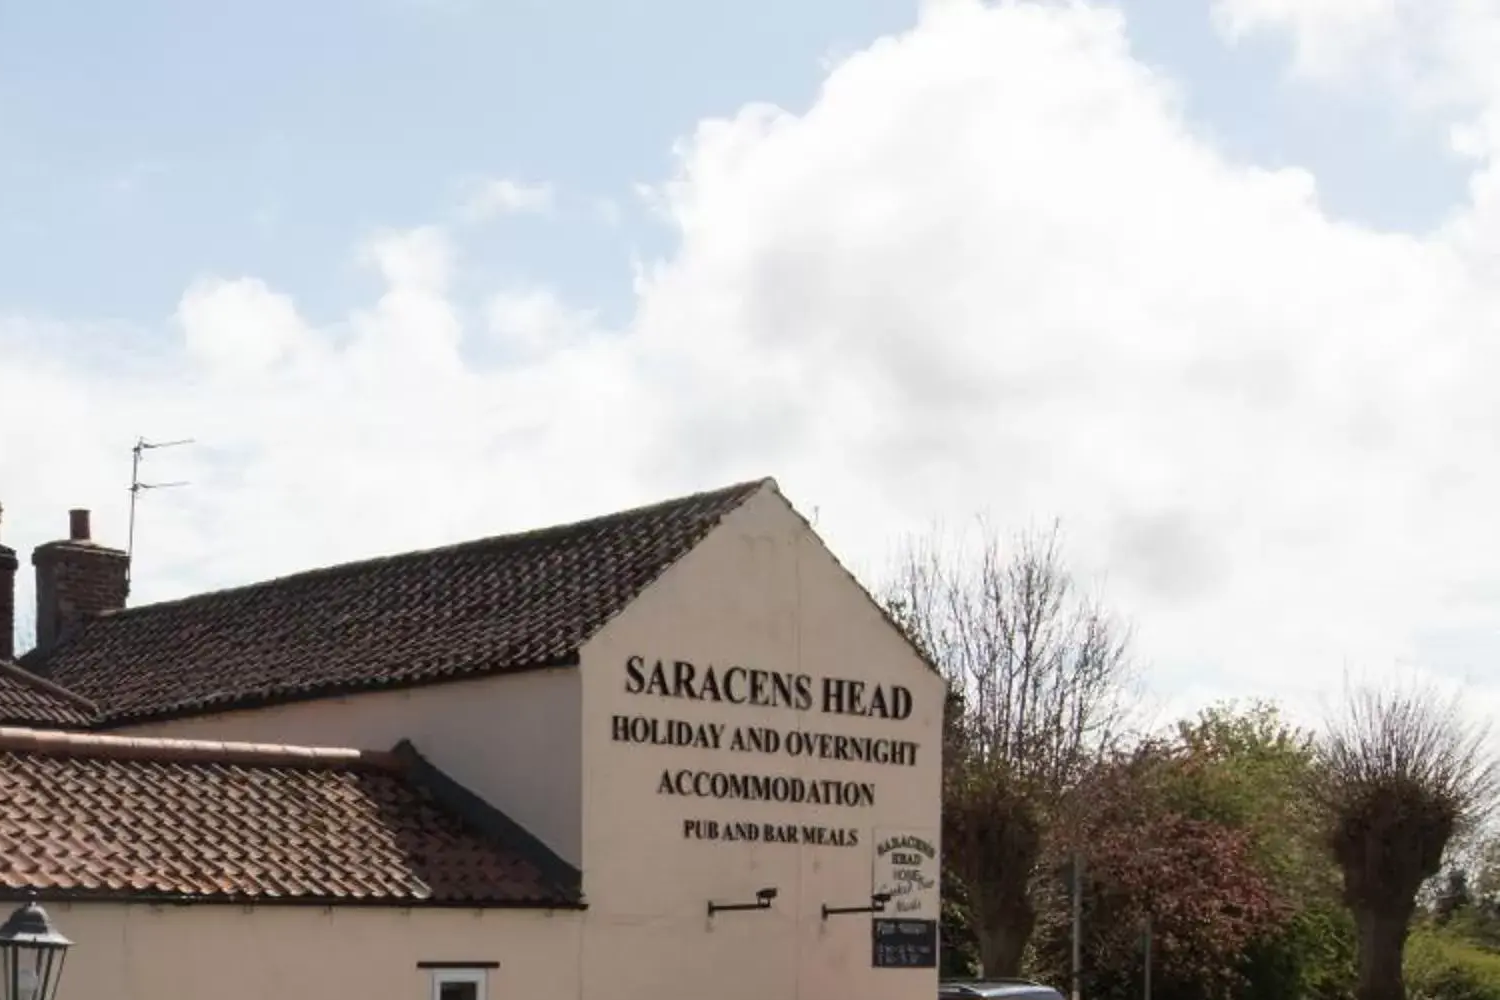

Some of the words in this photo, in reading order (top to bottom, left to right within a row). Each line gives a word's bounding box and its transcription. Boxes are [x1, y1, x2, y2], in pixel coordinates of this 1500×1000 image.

[625, 655, 813, 711] SARACENS
[821, 677, 913, 721] HEAD
[612, 714, 725, 749] HOLIDAY
[730, 726, 781, 753] AND
[785, 731, 921, 767] OVERNIGHT
[657, 768, 875, 806] ACCOMMODATION
[683, 819, 719, 840] PUB
[722, 821, 759, 842] AND
[763, 823, 798, 844] BAR
[802, 826, 859, 847] MEALS
